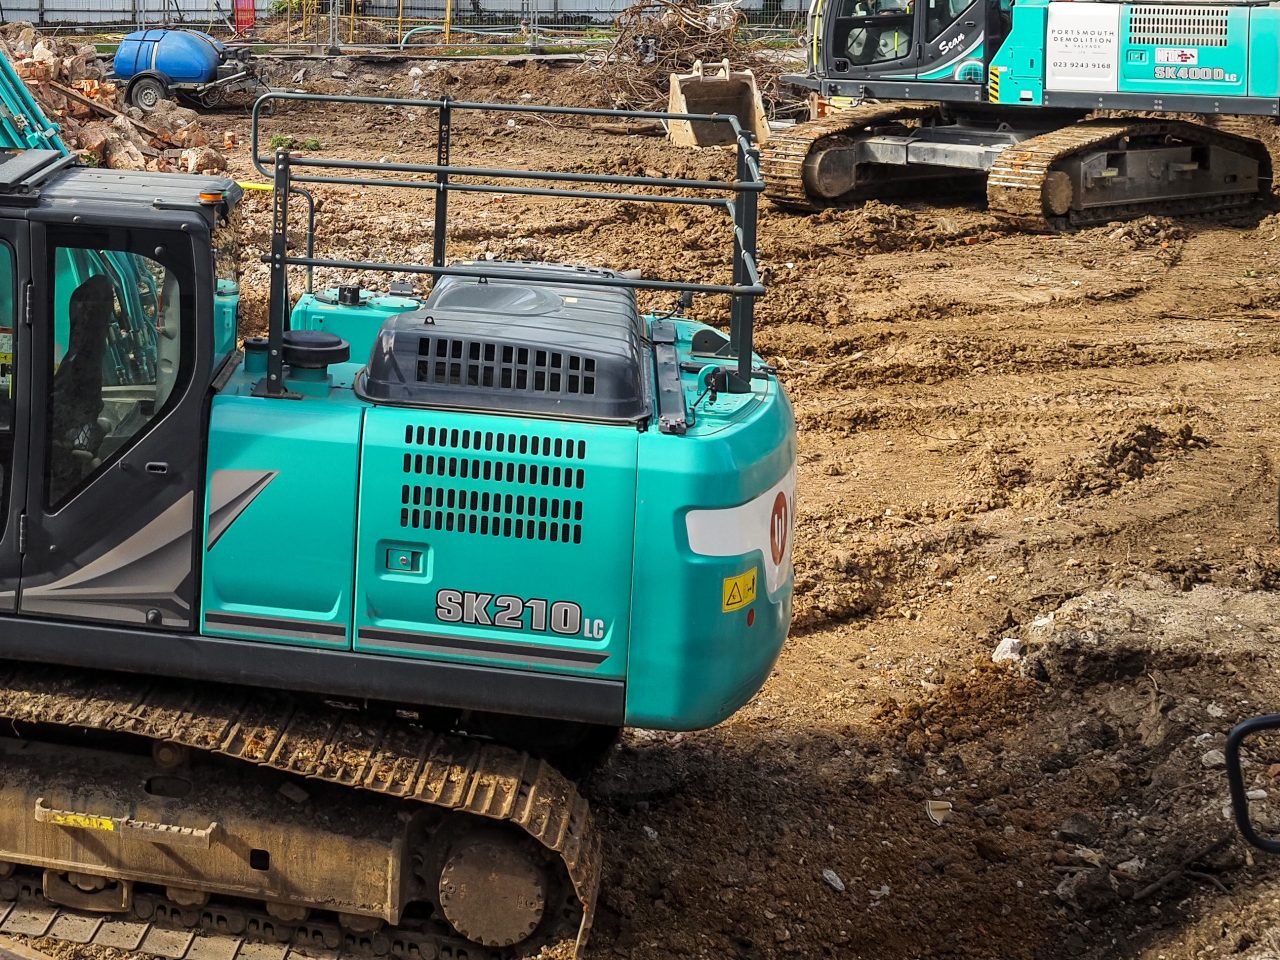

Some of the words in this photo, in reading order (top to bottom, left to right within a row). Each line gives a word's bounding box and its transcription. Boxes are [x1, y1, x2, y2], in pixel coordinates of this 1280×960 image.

[939, 33, 965, 55] Sean
[1053, 36, 1112, 44] DEMOLITION
[1224, 73, 1238, 82] LC
[435, 588, 582, 635] SK210
[583, 618, 604, 639] LC
